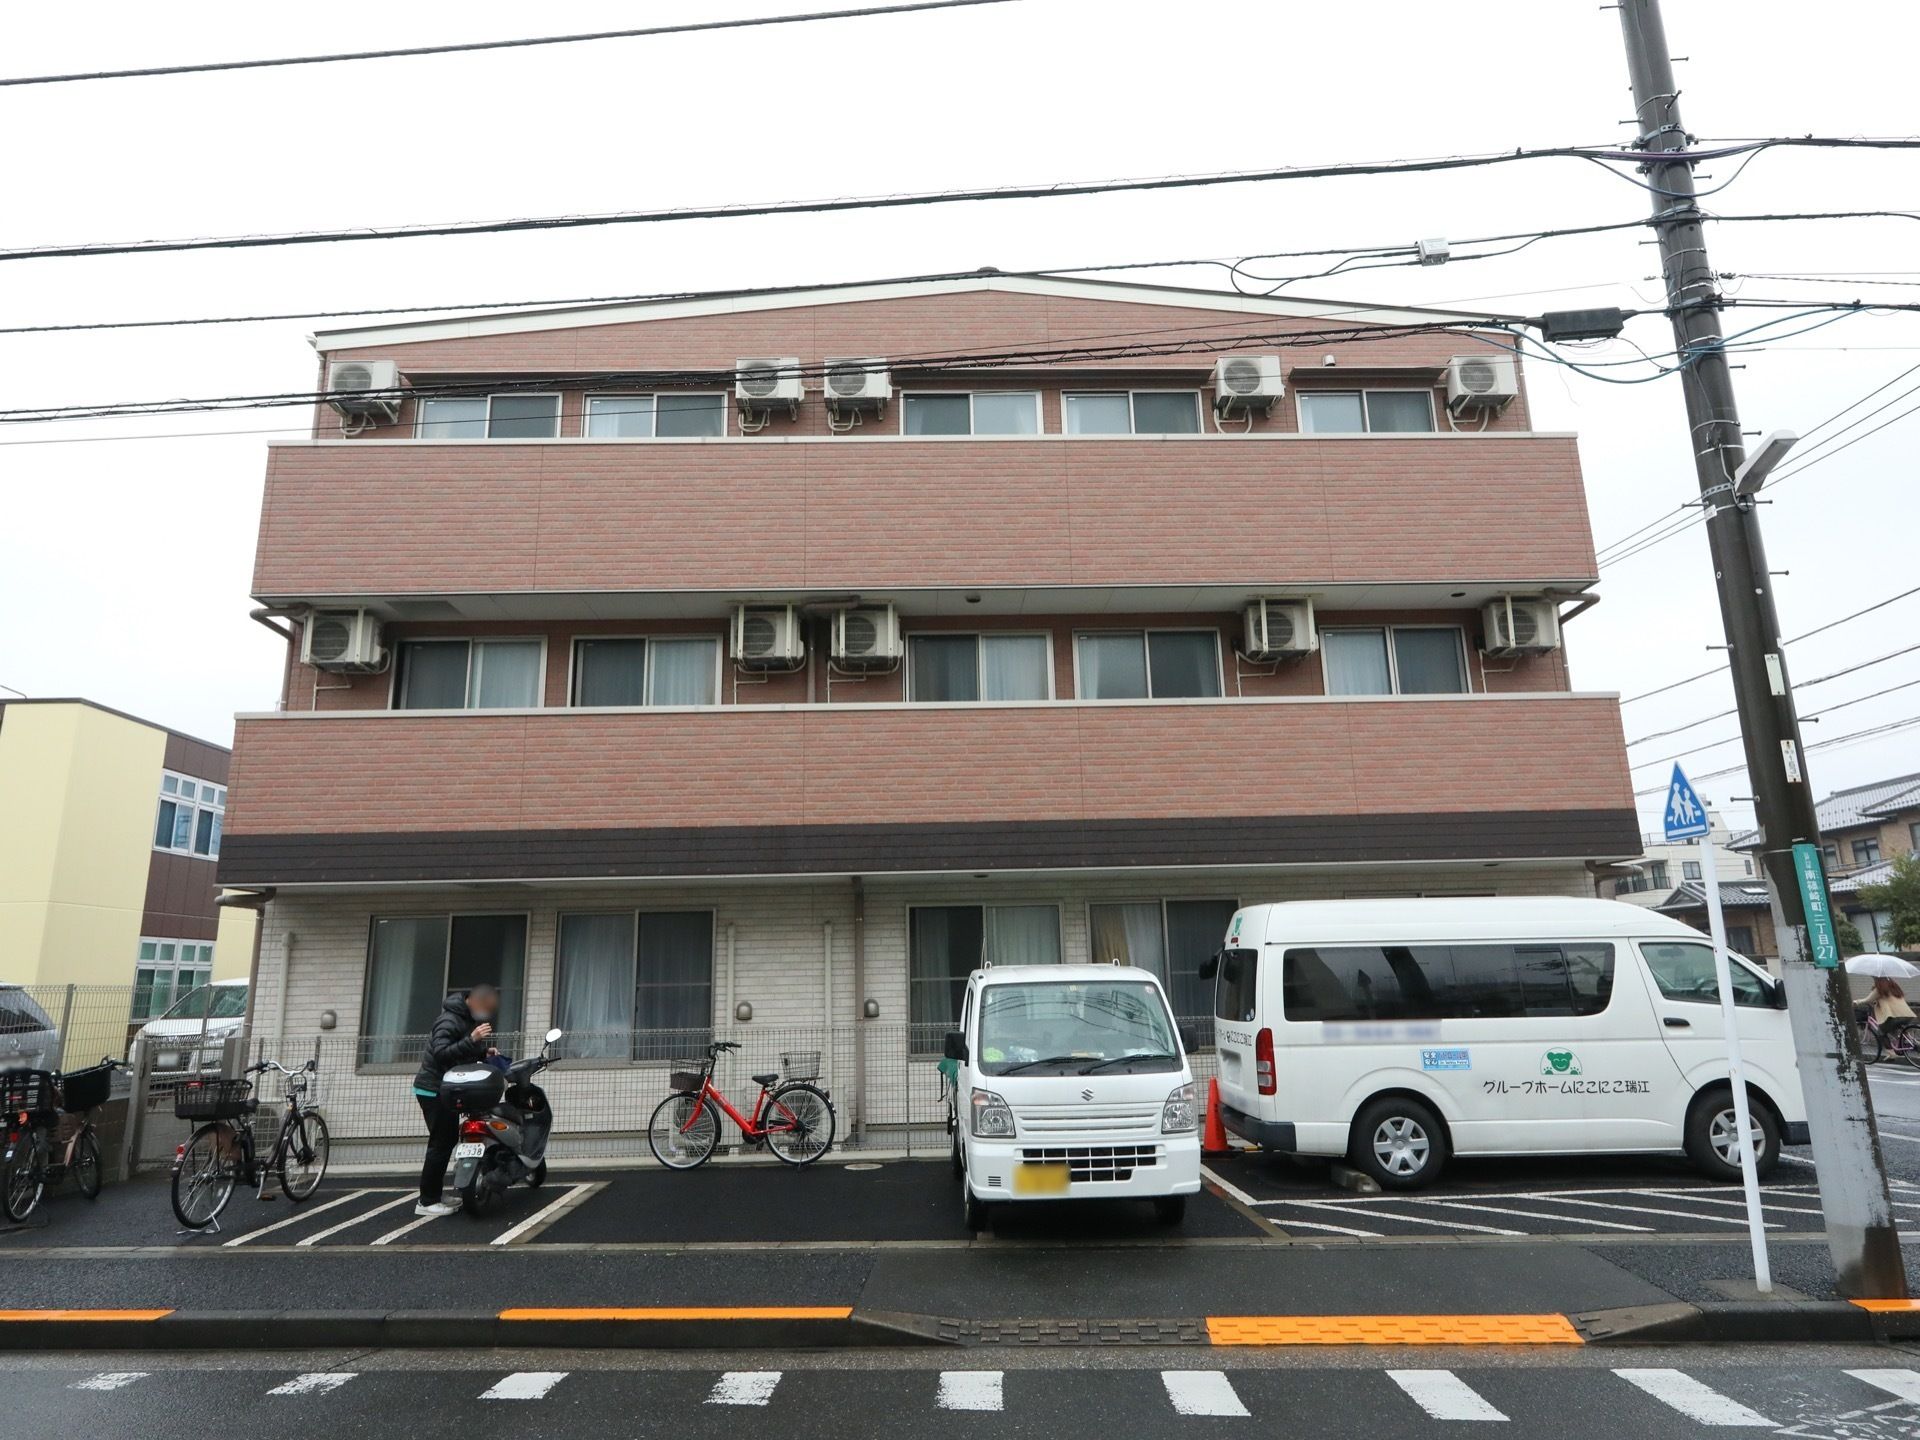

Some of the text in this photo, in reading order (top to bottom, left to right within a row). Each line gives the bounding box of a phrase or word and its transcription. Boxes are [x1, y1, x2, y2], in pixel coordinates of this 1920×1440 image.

[1482, 1080, 1651, 1095] グループホームにこにこ瑞江
